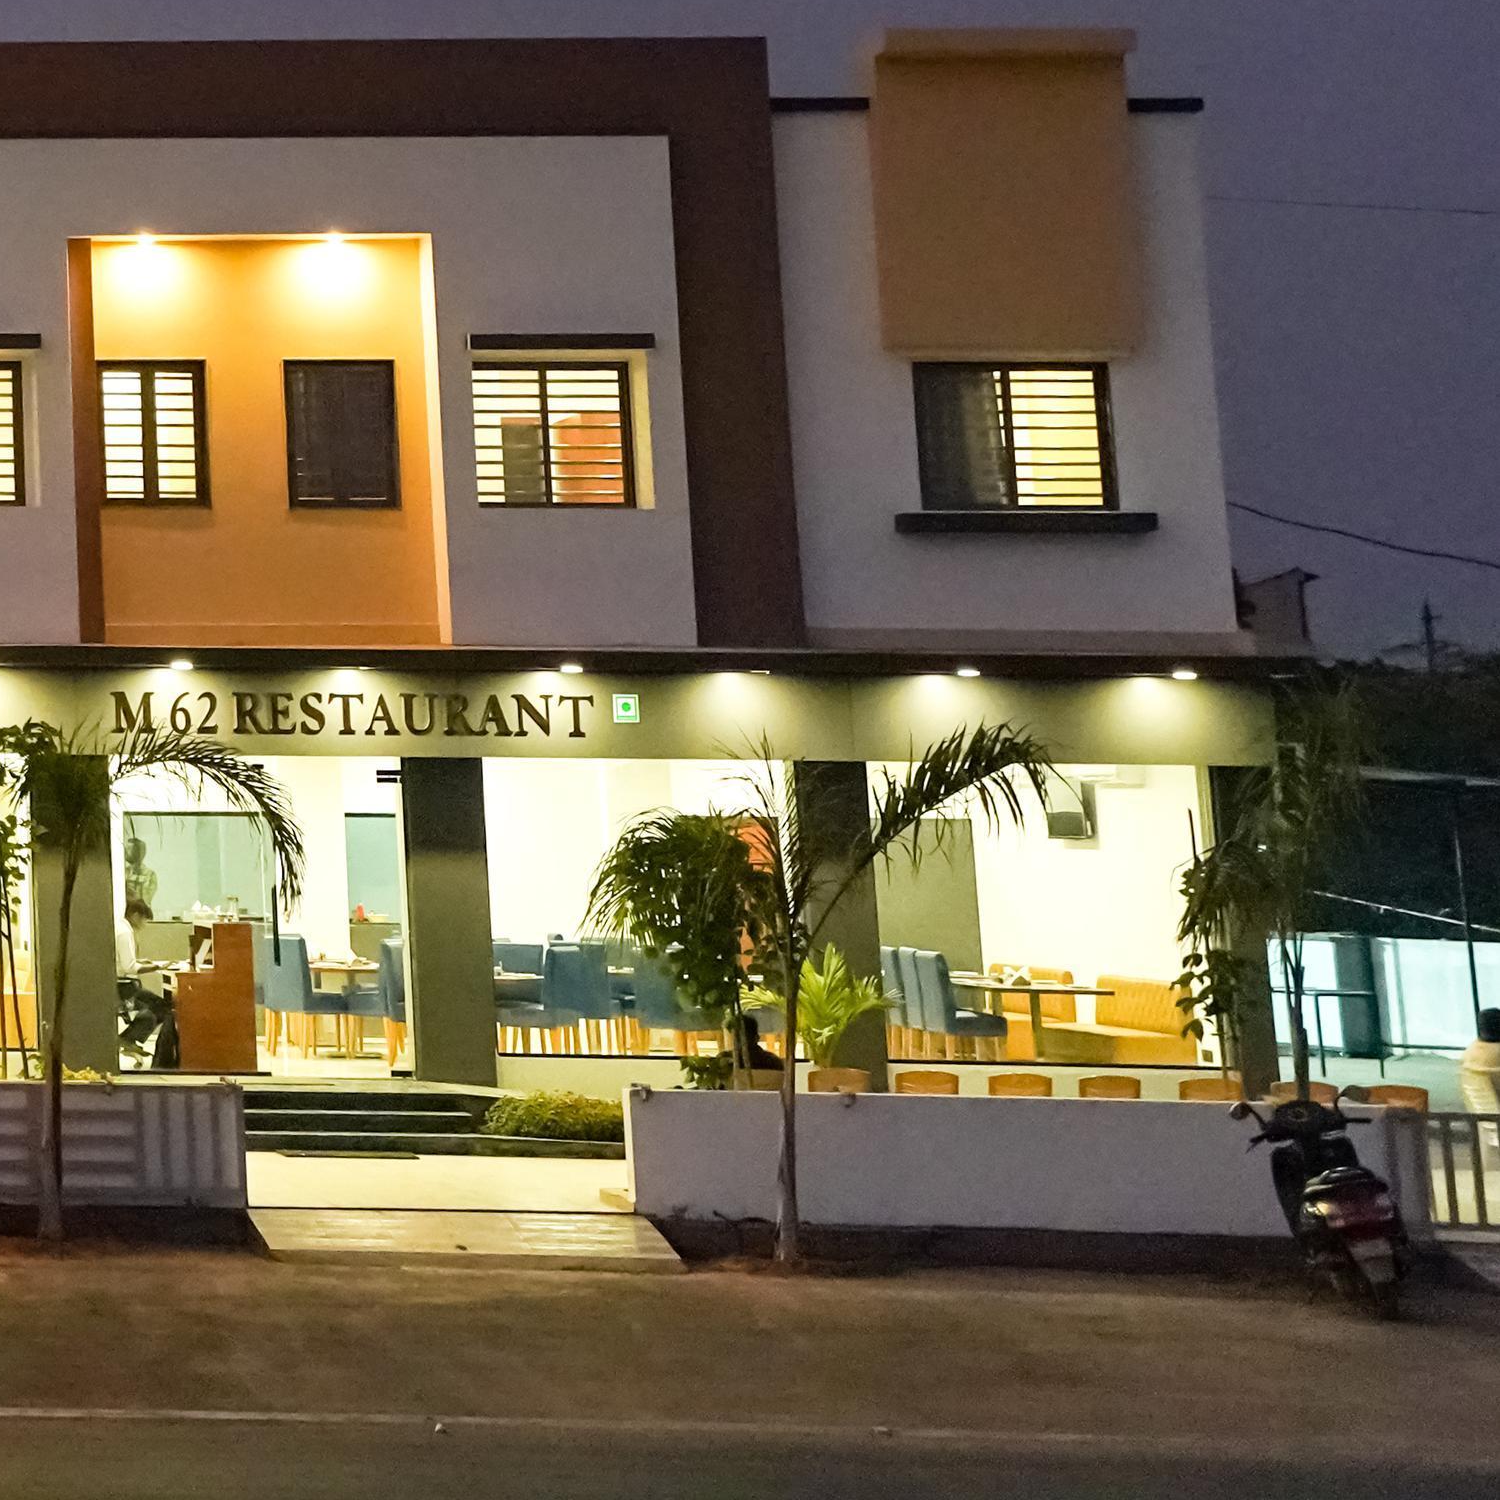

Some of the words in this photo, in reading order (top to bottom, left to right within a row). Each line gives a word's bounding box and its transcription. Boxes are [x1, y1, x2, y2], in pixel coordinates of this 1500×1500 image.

[110, 691, 156, 735] M
[169, 691, 218, 735] 62
[232, 692, 595, 738] RESTAURANT
